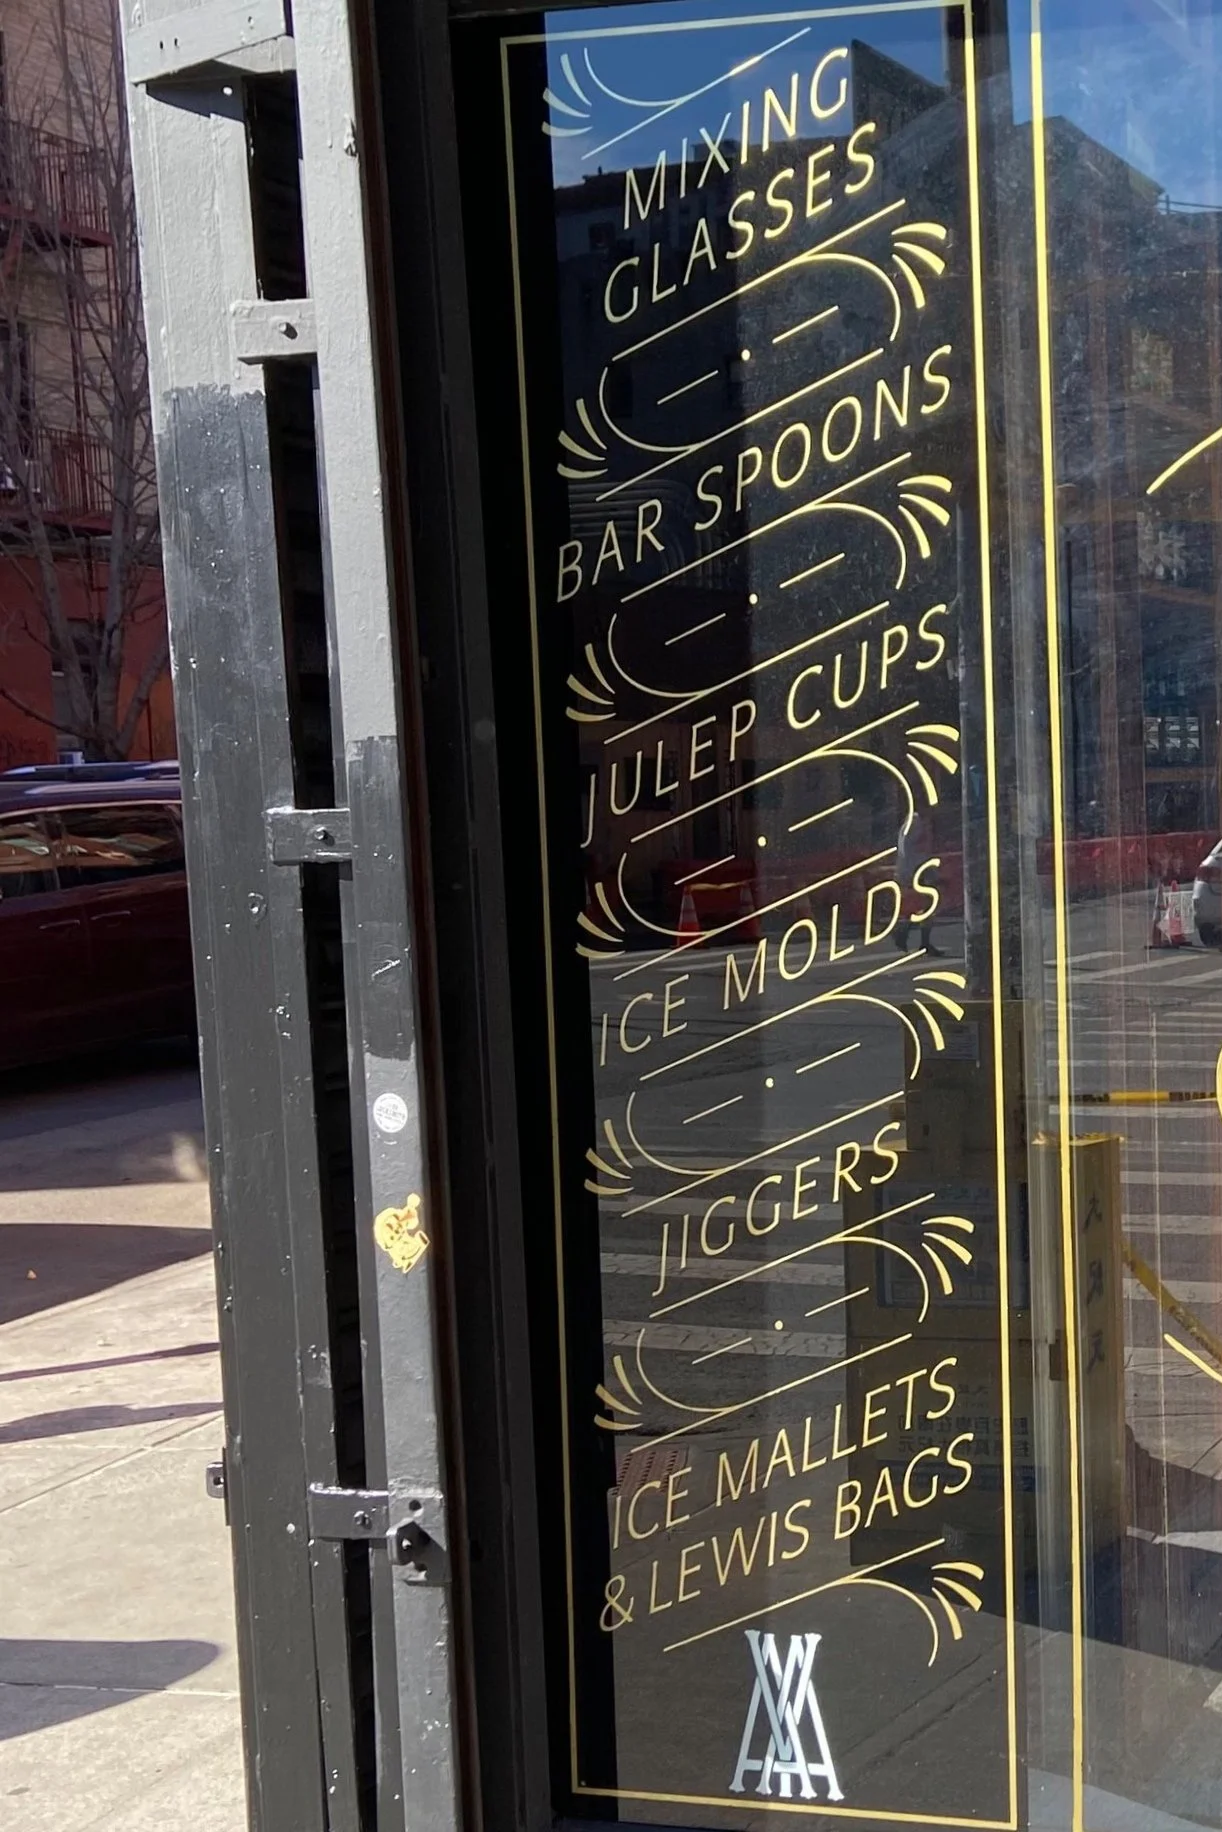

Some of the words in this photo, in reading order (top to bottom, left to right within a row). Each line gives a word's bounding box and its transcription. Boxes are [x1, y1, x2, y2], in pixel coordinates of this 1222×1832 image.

[603, 120, 877, 324] GLASSES
[623, 47, 849, 230] MIXING
[557, 499, 666, 603] BAR
[694, 345, 952, 531] SPOONS
[580, 700, 757, 848] JULEP
[787, 604, 947, 730] CUPS
[599, 974, 690, 1067] ICE
[723, 858, 940, 1010] MOLDS
[652, 1121, 901, 1297] JIGGERS
[612, 1466, 708, 1550] ICE
[716, 1357, 957, 1509] MALLETS
[834, 1433, 975, 1541] BAGS
